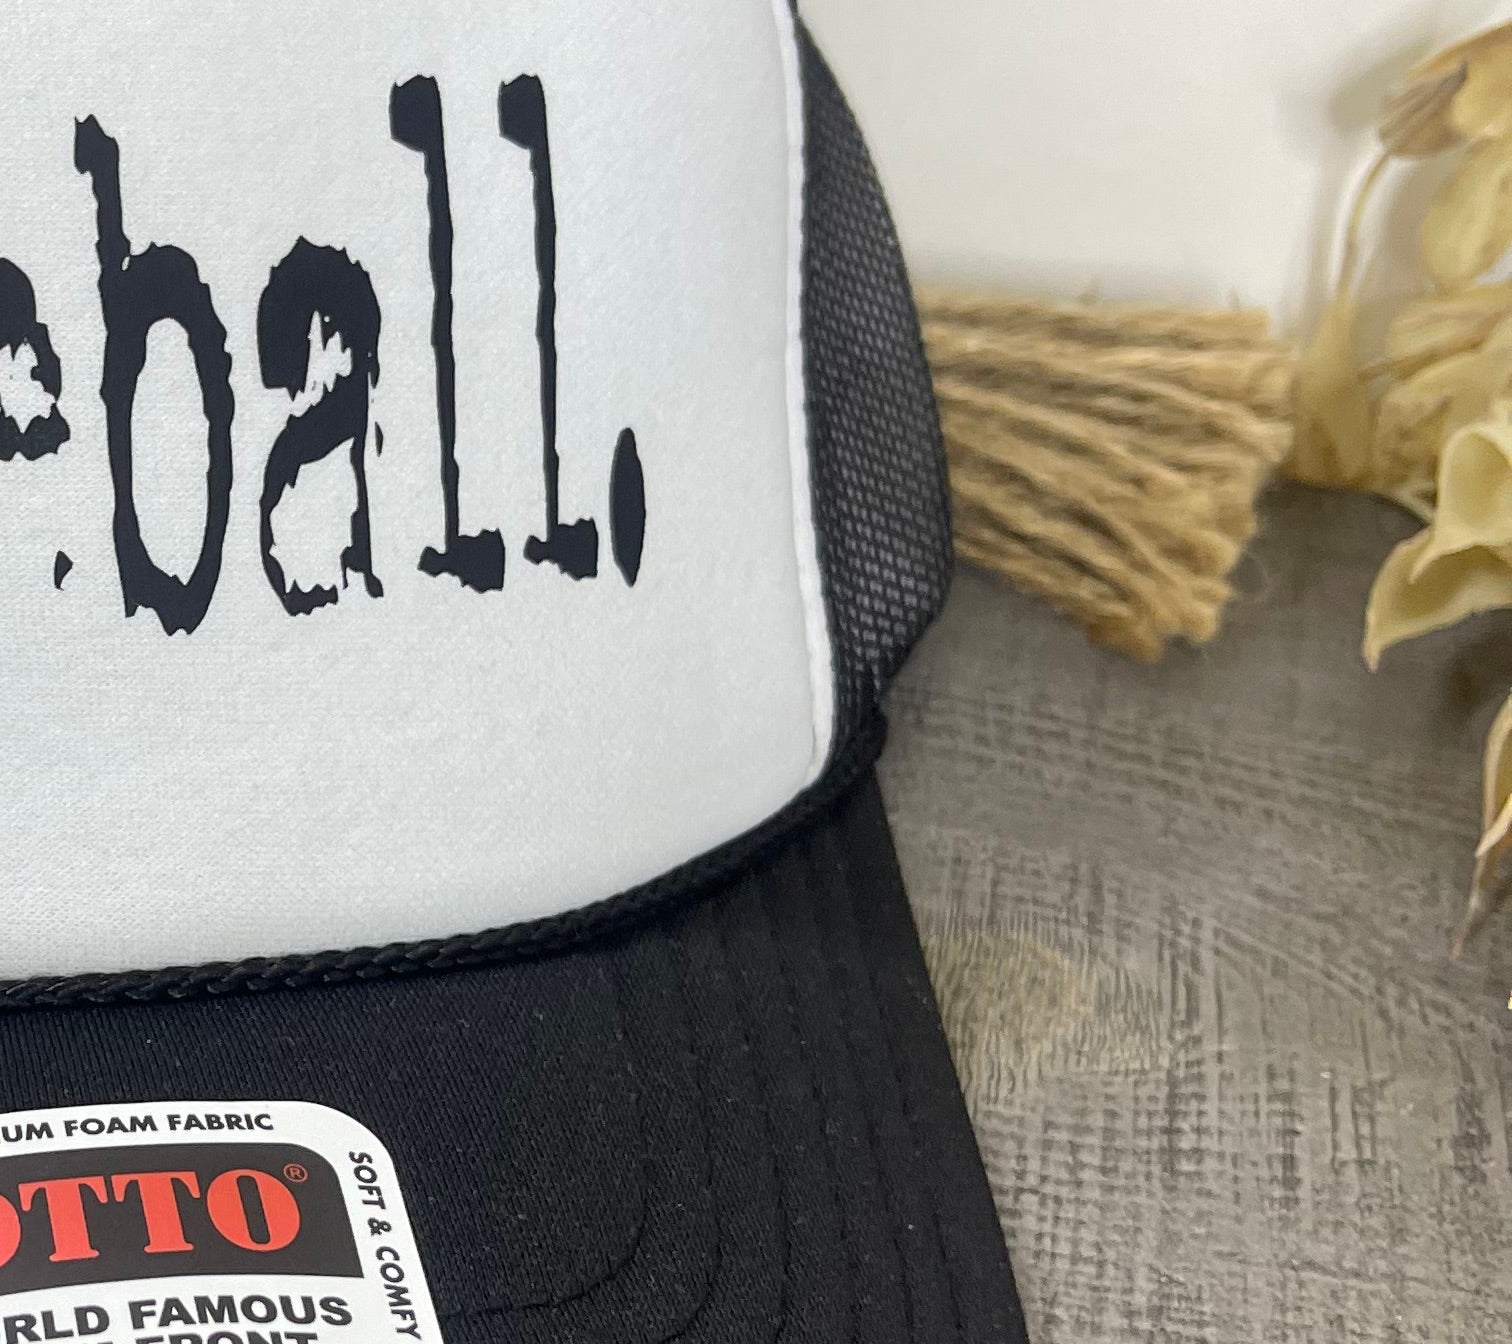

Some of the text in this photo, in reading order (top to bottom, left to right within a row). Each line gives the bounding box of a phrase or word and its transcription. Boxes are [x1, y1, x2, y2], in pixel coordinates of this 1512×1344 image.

[64, 1115, 158, 1137] FOAM
[166, 1113, 274, 1132] FABRIC
[349, 1150, 386, 1212] SOFT
[369, 1220, 390, 1236] &
[375, 1247, 421, 1338] COMFY
[129, 1294, 353, 1326] FAMOUS
